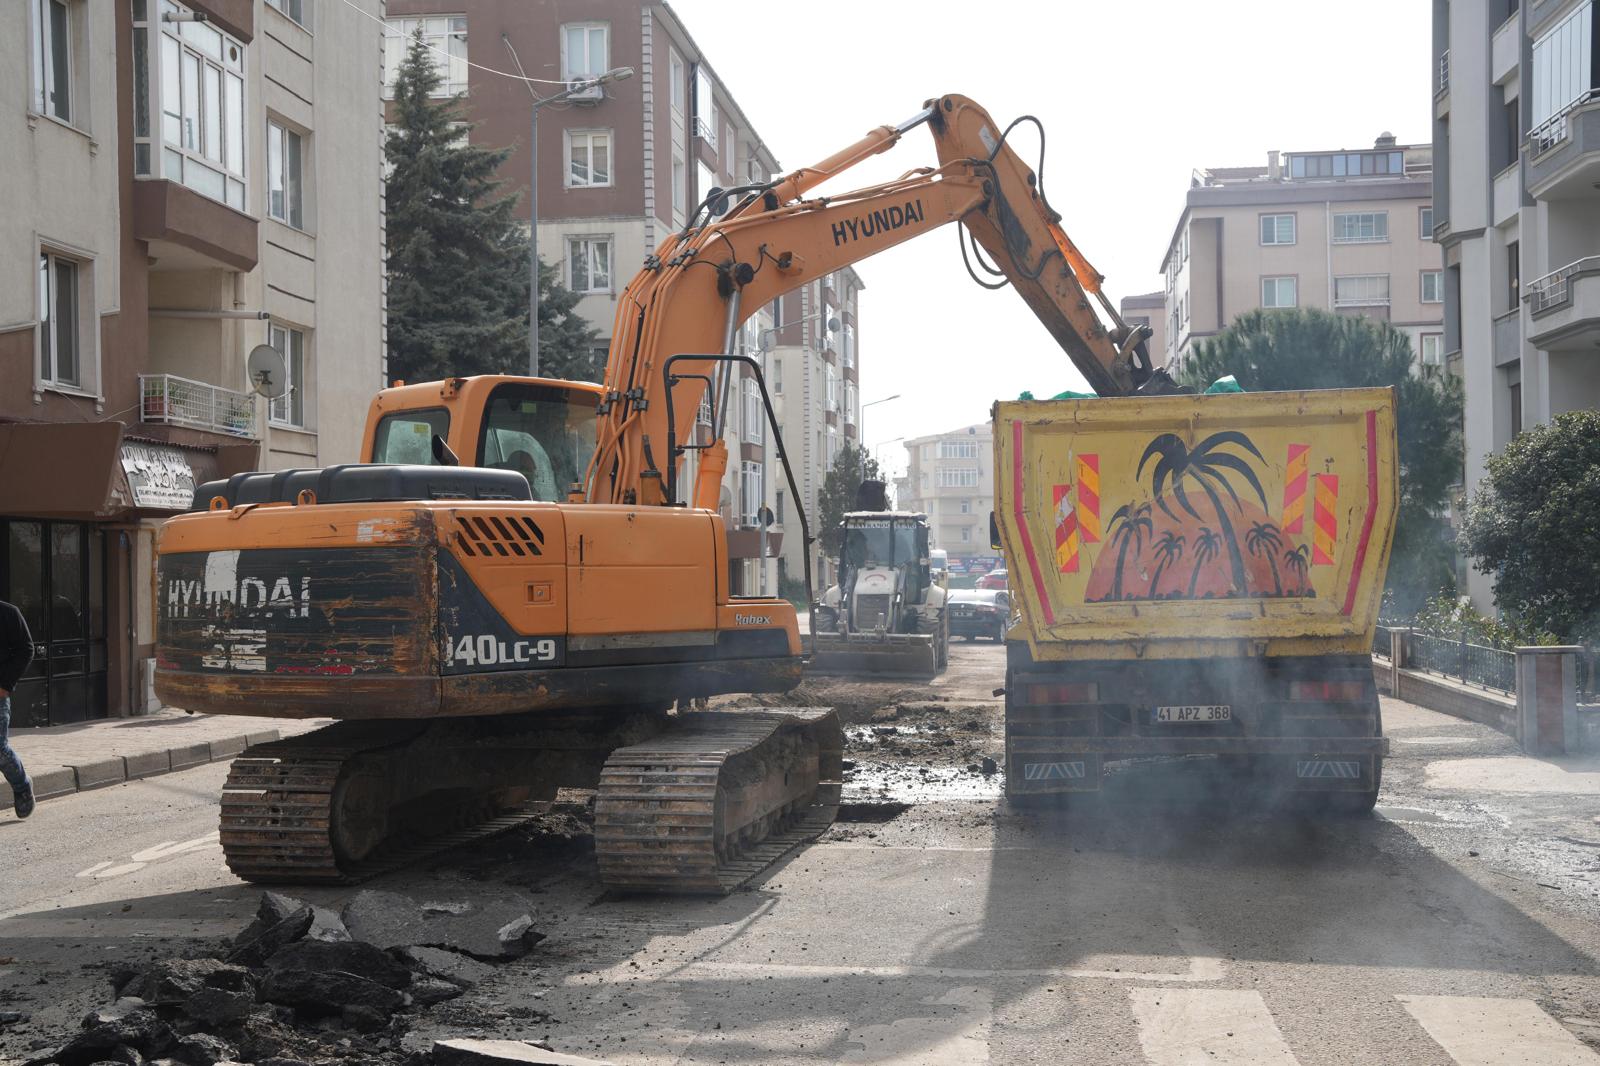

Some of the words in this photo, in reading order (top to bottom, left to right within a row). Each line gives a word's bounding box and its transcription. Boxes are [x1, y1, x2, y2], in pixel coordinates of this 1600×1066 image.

[831, 199, 924, 246] HYUNDAI
[168, 576, 311, 618] HYUNDAI
[735, 613, 772, 626] Robex
[1158, 707, 1171, 721] 41
[1177, 707, 1201, 720] APZ
[1207, 706, 1230, 720] 368
